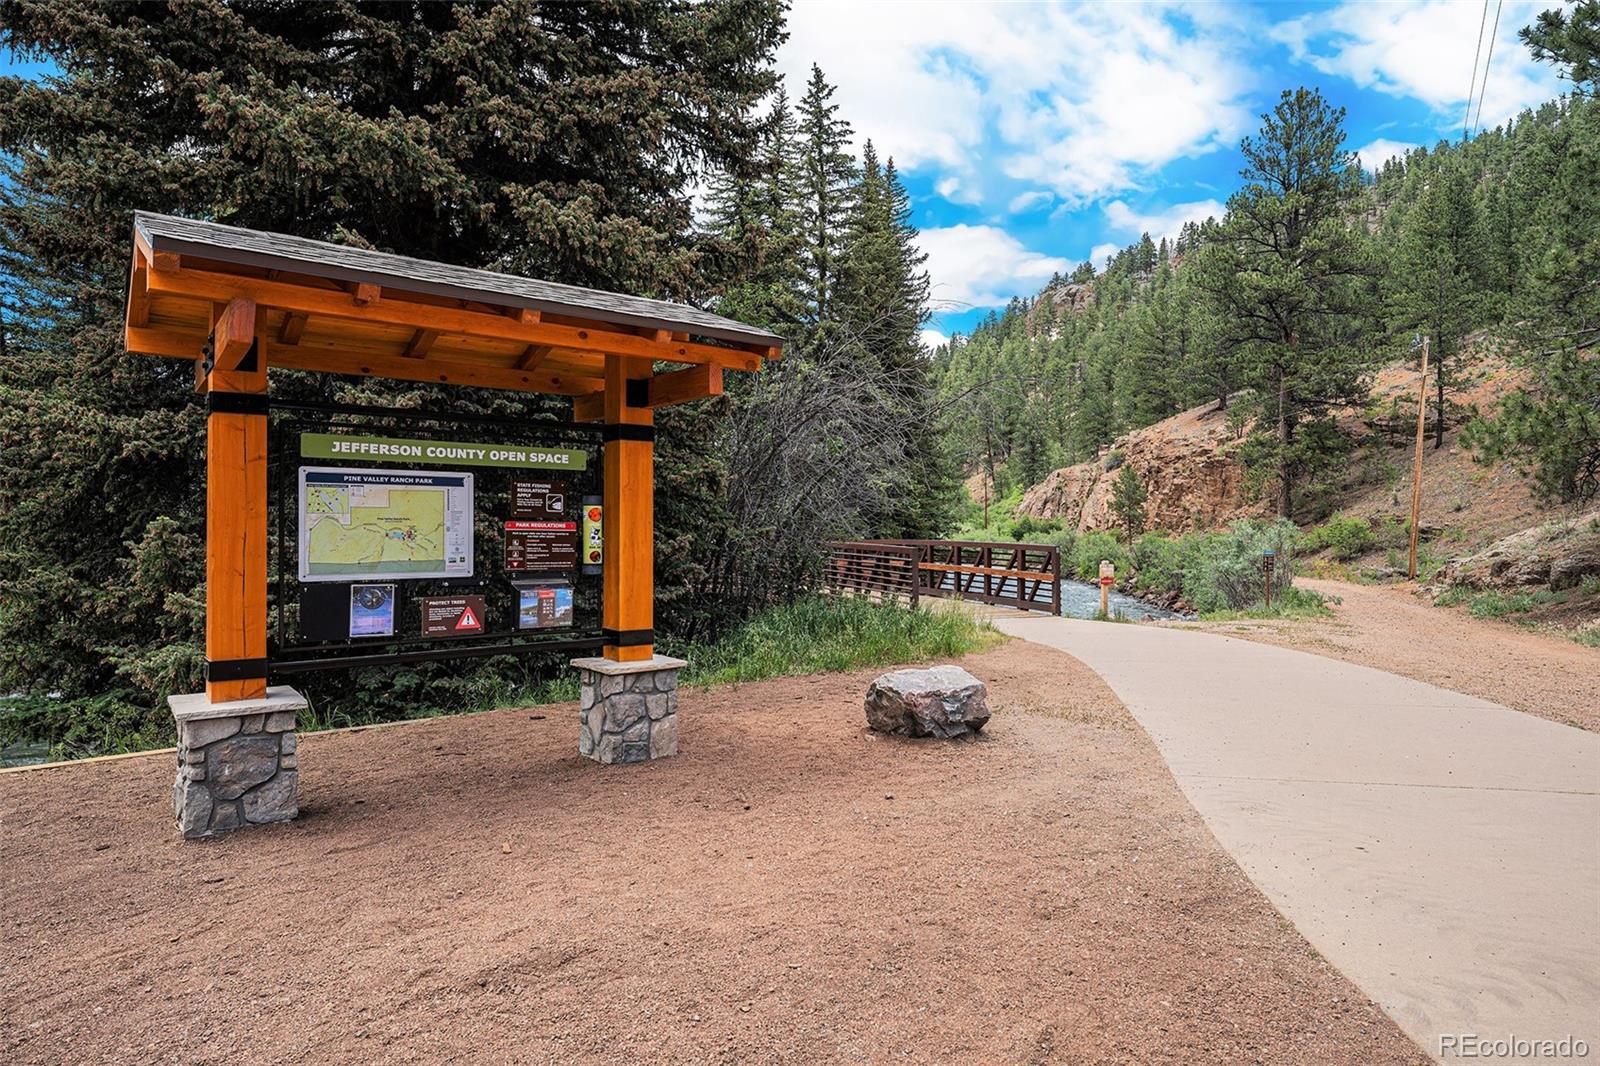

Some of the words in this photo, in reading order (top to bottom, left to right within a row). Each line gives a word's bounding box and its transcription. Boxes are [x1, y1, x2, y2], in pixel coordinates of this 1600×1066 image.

[331, 441, 422, 457] JEFFERSON
[426, 446, 486, 460] COUNTY
[489, 450, 526, 462] OPEN
[529, 452, 569, 464] SPACE
